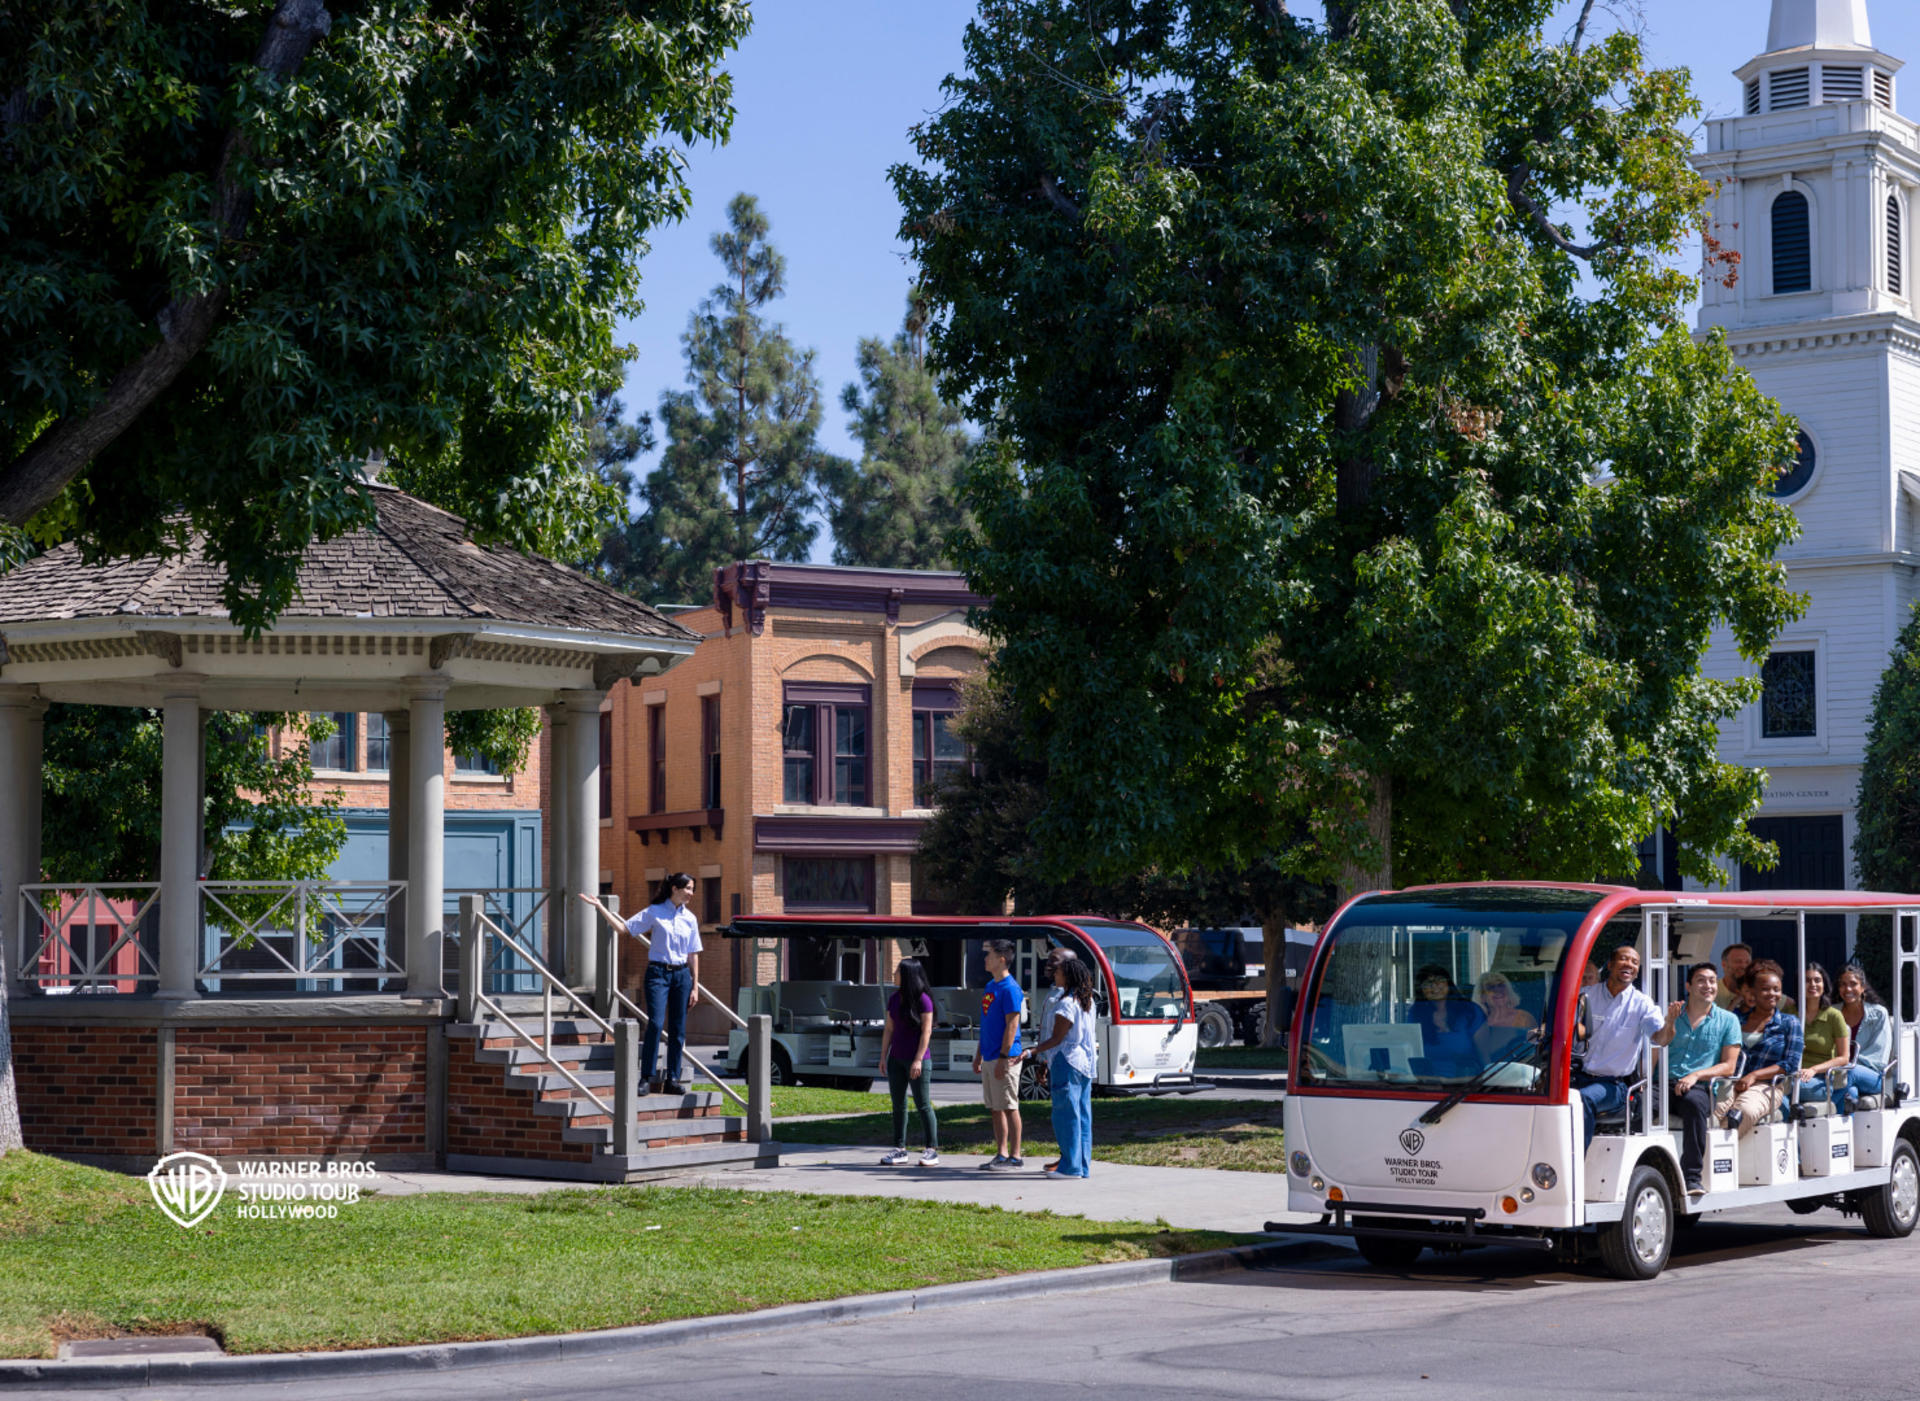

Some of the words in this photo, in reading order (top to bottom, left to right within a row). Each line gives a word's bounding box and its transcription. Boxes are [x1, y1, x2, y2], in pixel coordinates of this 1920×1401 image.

[1796, 790, 1829, 798] CENTER
[1402, 1132, 1420, 1151] WB
[1384, 1157, 1418, 1168] WARNER
[1390, 1167, 1417, 1177] STUDIO
[1418, 1169, 1438, 1178] TOUR
[1395, 1177, 1435, 1185] HOLLYWOOD
